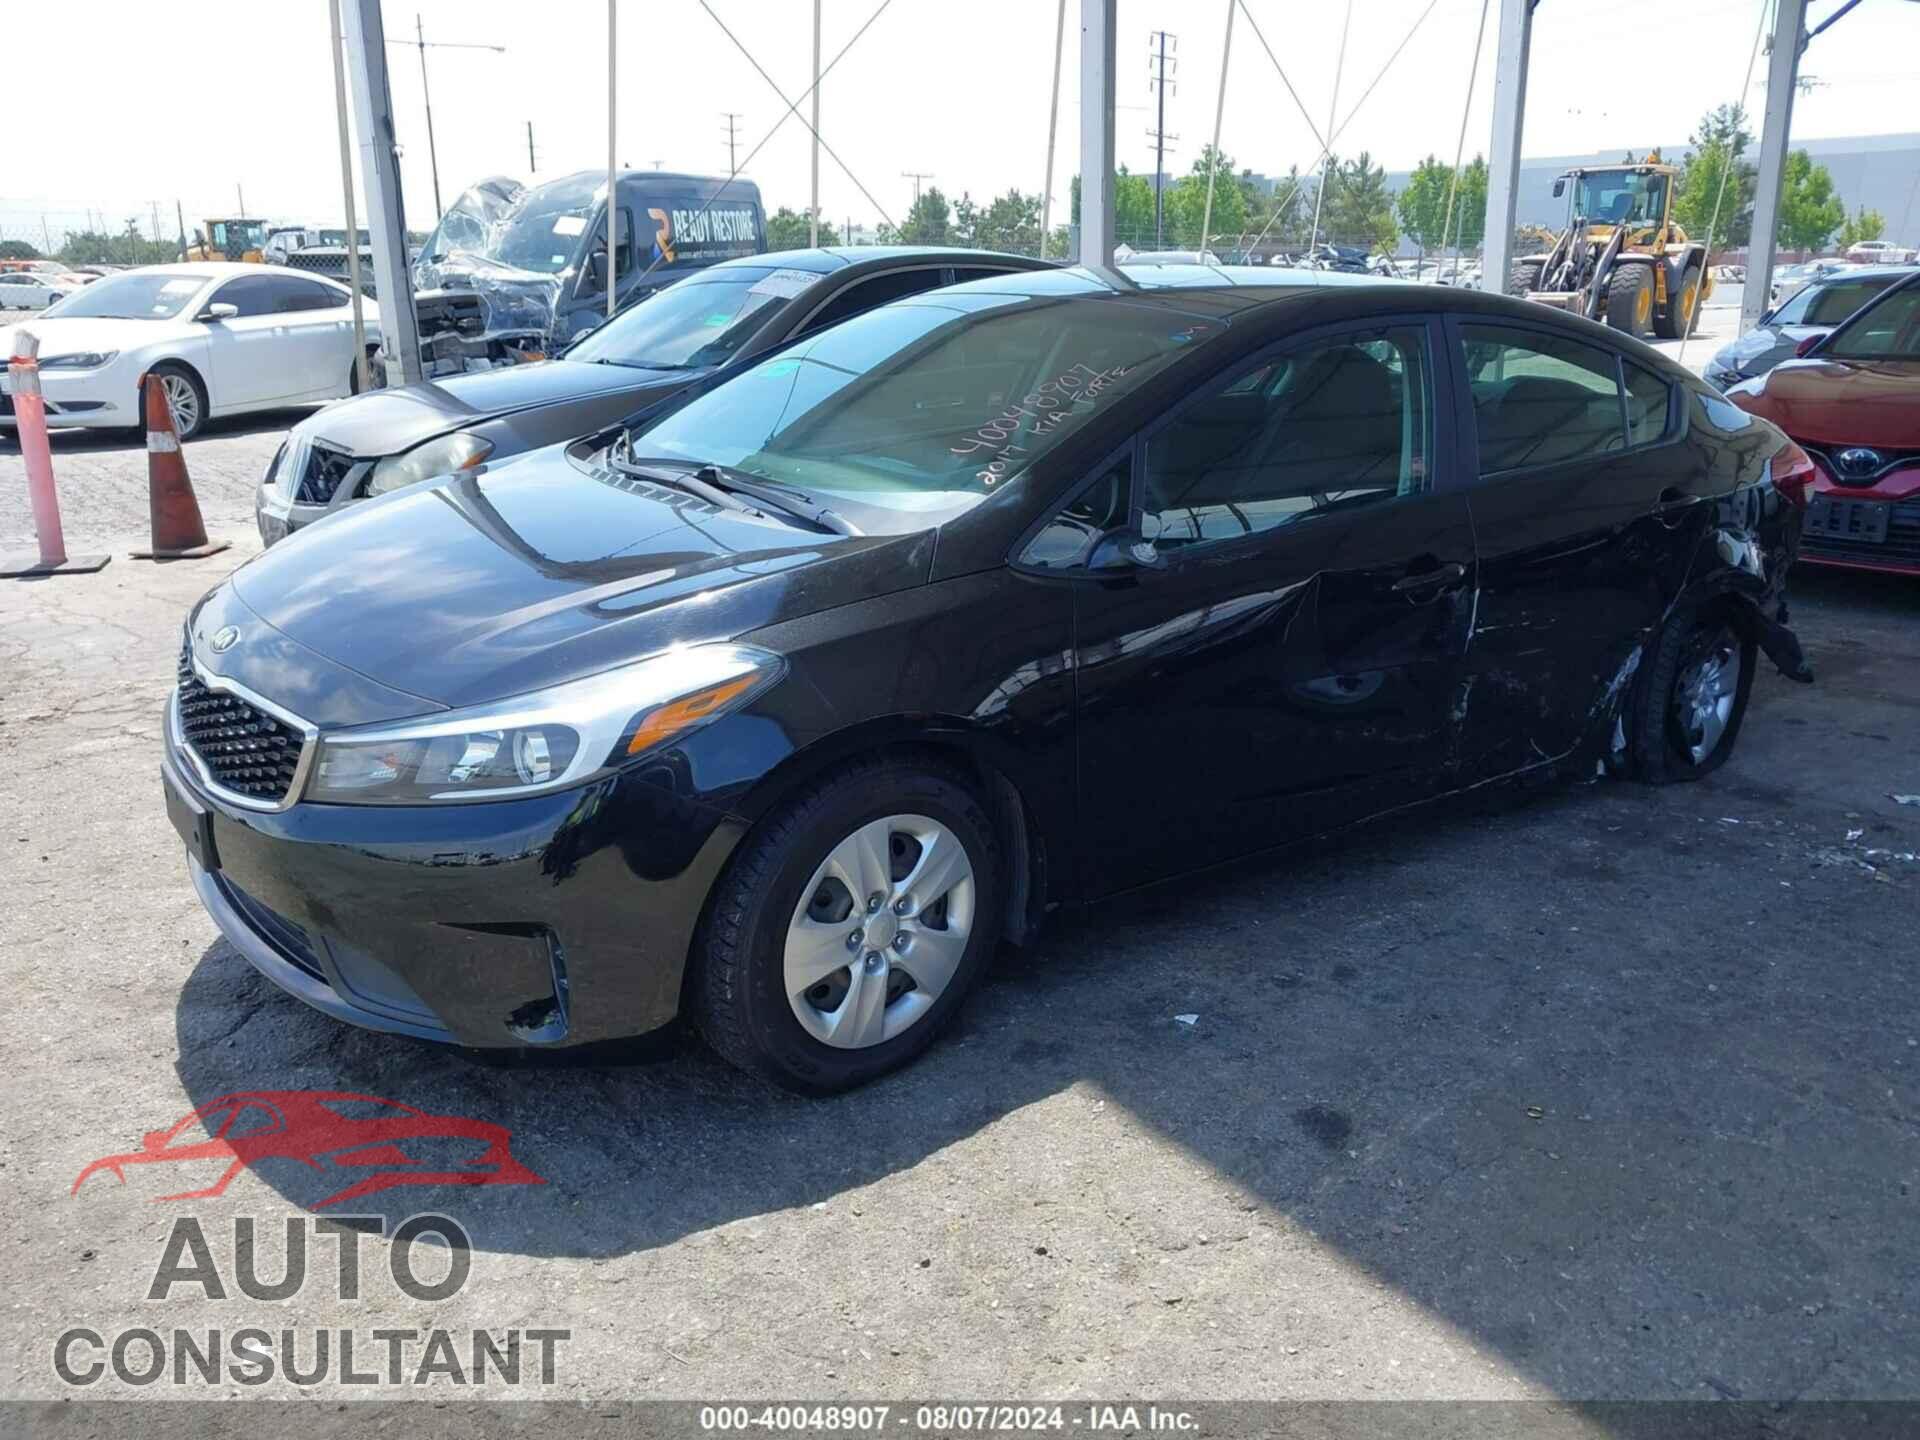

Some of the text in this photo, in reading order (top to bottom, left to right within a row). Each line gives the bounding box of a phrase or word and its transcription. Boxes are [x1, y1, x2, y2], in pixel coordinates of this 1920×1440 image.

[671, 209, 756, 243] READY RESTORE
[950, 362, 1104, 454] 40048907
[975, 444, 1028, 486] 2017
[1026, 409, 1073, 436] KIA
